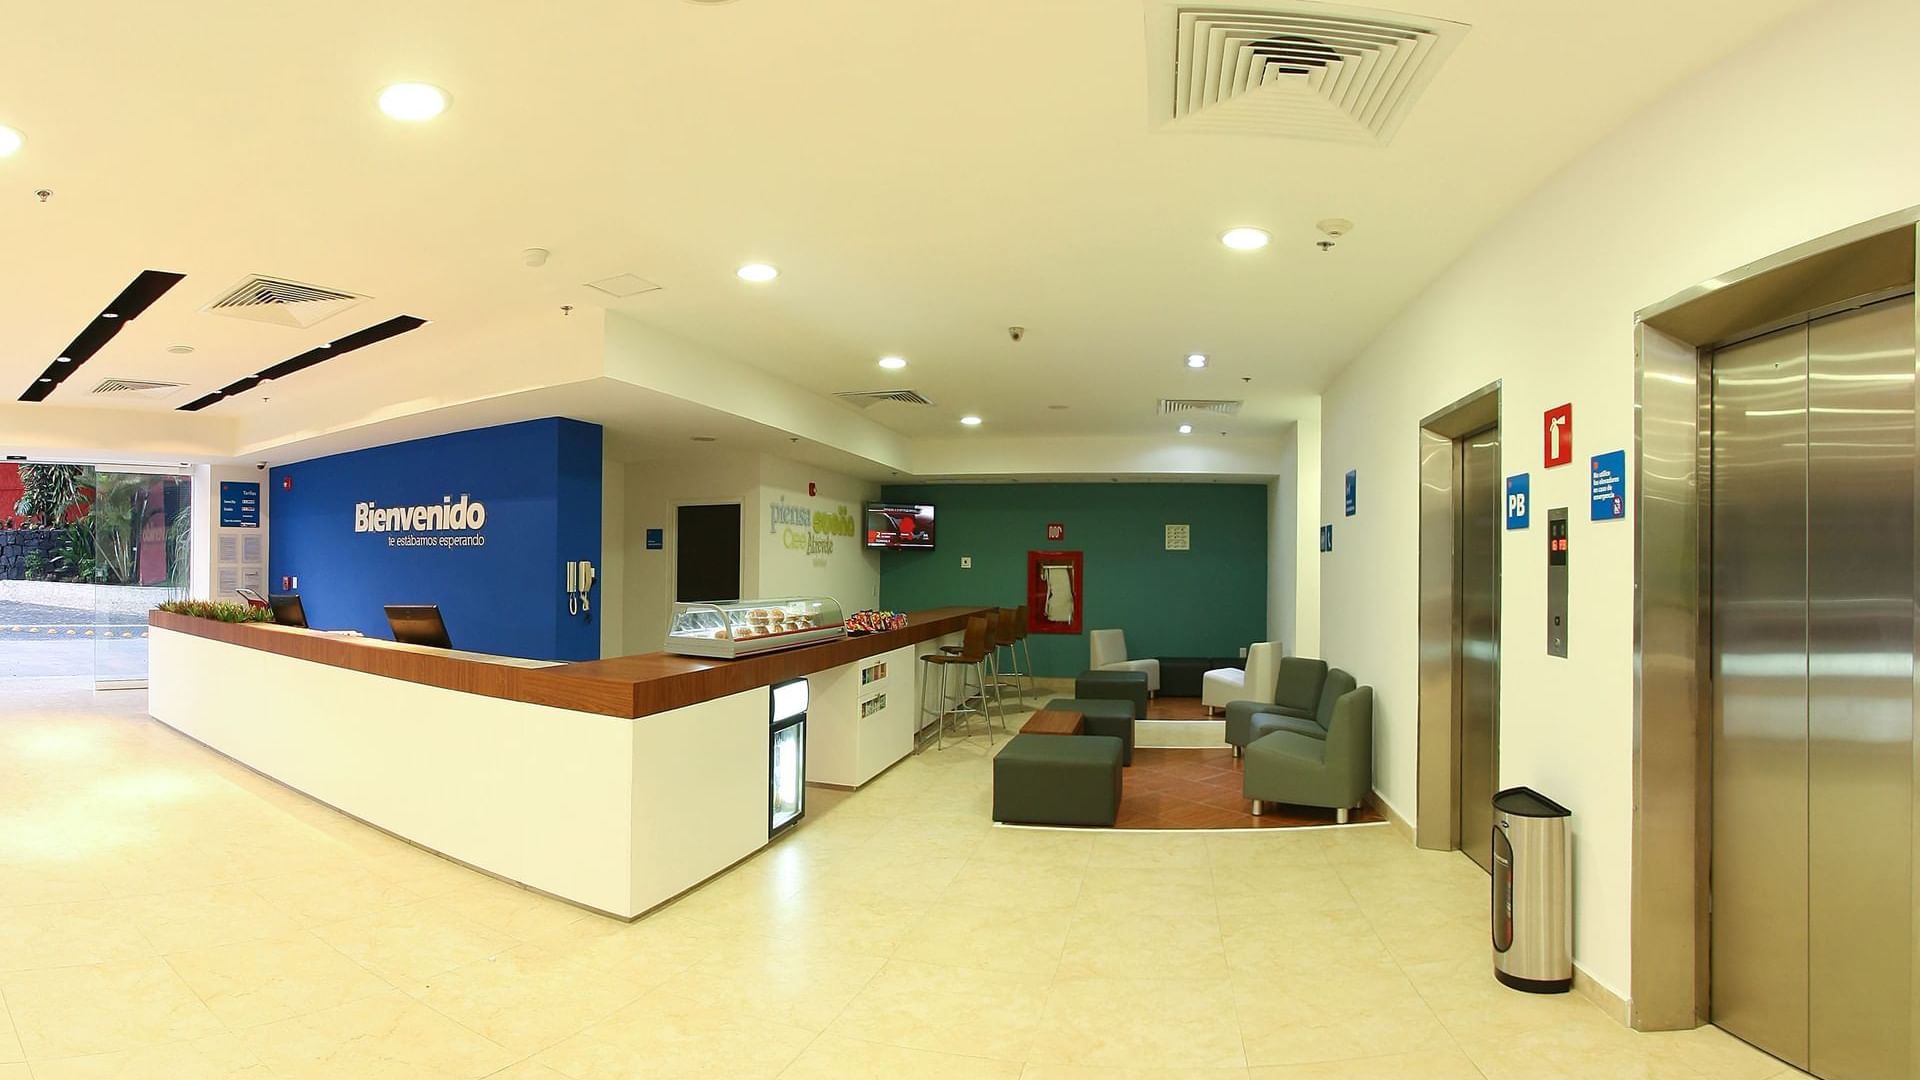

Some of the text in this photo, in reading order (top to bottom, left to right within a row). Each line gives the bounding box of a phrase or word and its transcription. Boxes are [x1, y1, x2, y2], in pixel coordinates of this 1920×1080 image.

[355, 495, 485, 532] Bienvenido
[769, 496, 811, 534] piensa
[1508, 493, 1525, 517] PB
[389, 537, 395, 546] te
[439, 534, 485, 549] esperando
